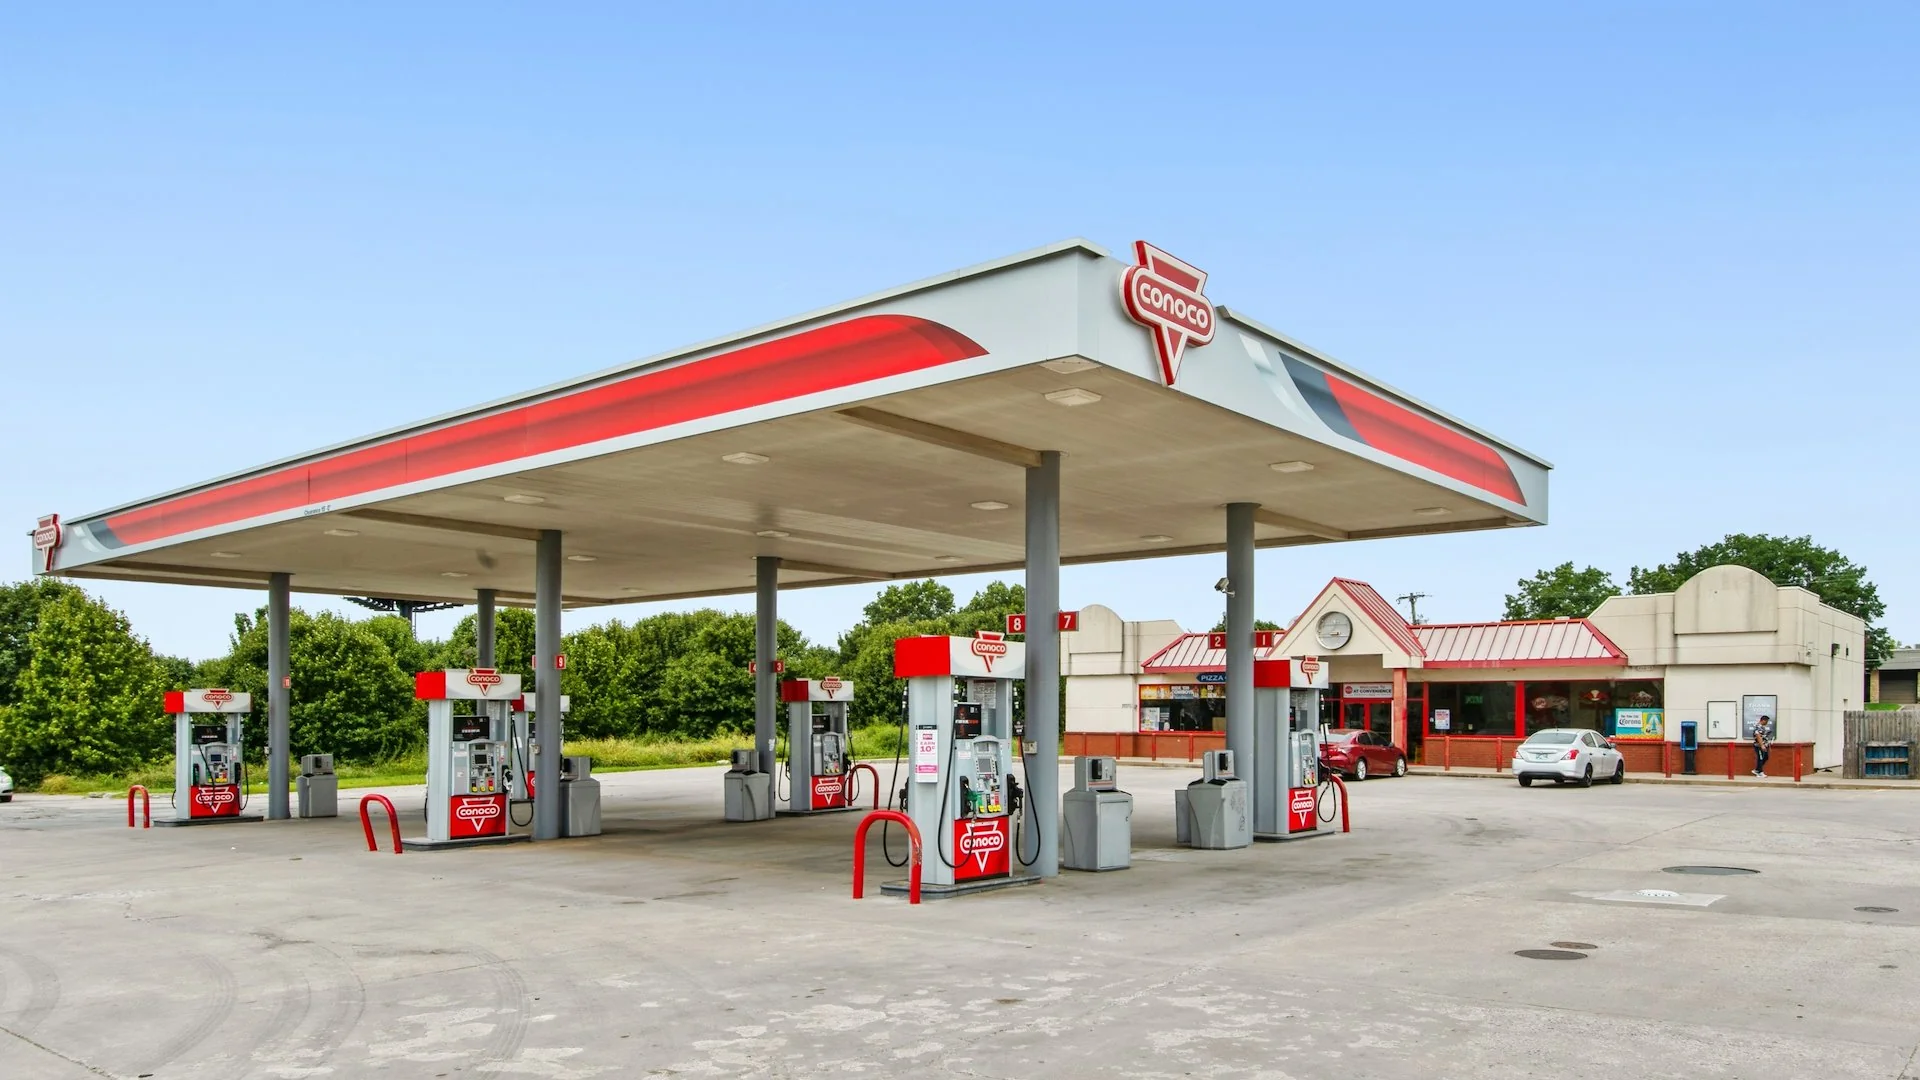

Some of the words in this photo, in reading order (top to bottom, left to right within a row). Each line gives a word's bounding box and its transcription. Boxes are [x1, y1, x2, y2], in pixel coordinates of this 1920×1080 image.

[1013, 617, 1022, 631] 8
[1063, 615, 1072, 629] 7
[1214, 636, 1222, 647] 2
[558, 657, 563, 667] 9
[777, 662, 782, 671] 3
[1619, 718, 1642, 726] Corona
